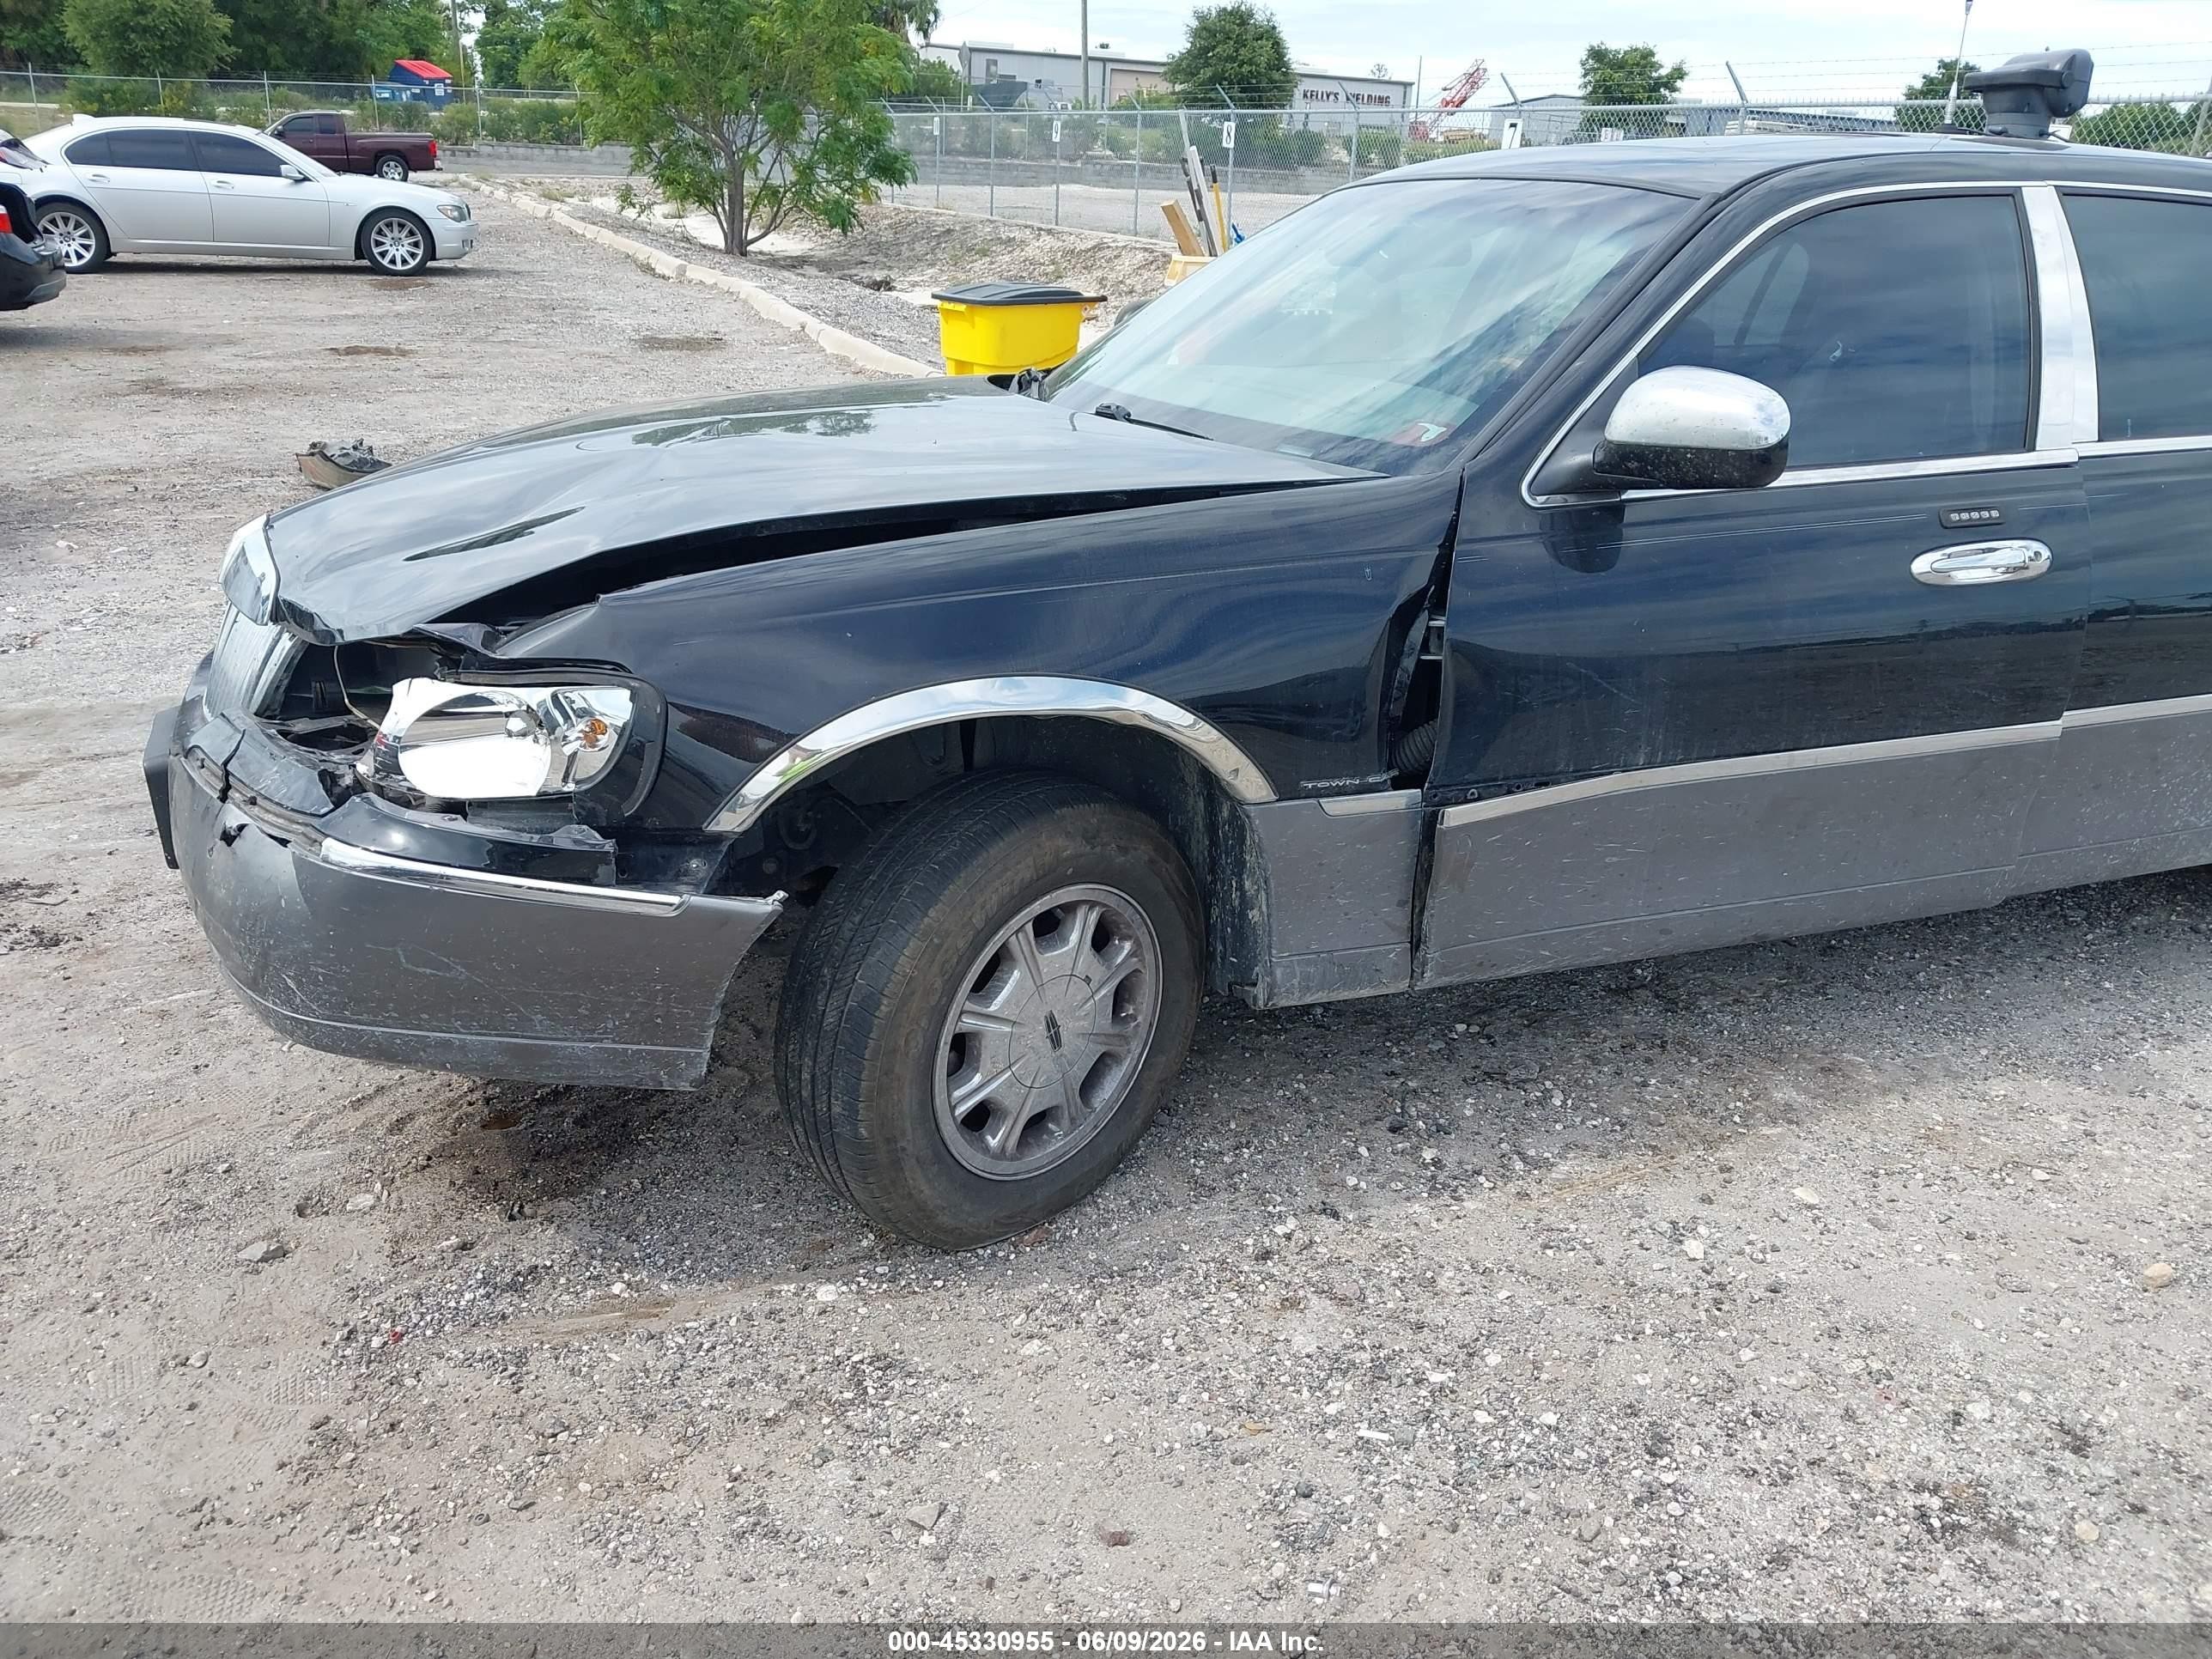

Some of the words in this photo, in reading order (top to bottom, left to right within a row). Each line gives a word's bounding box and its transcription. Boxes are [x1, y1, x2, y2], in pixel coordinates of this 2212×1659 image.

[1303, 88, 1340, 101] KELLY'S
[1225, 124, 1232, 145] 8
[1508, 122, 1519, 149] 7
[1303, 779, 1360, 789] TOWN
